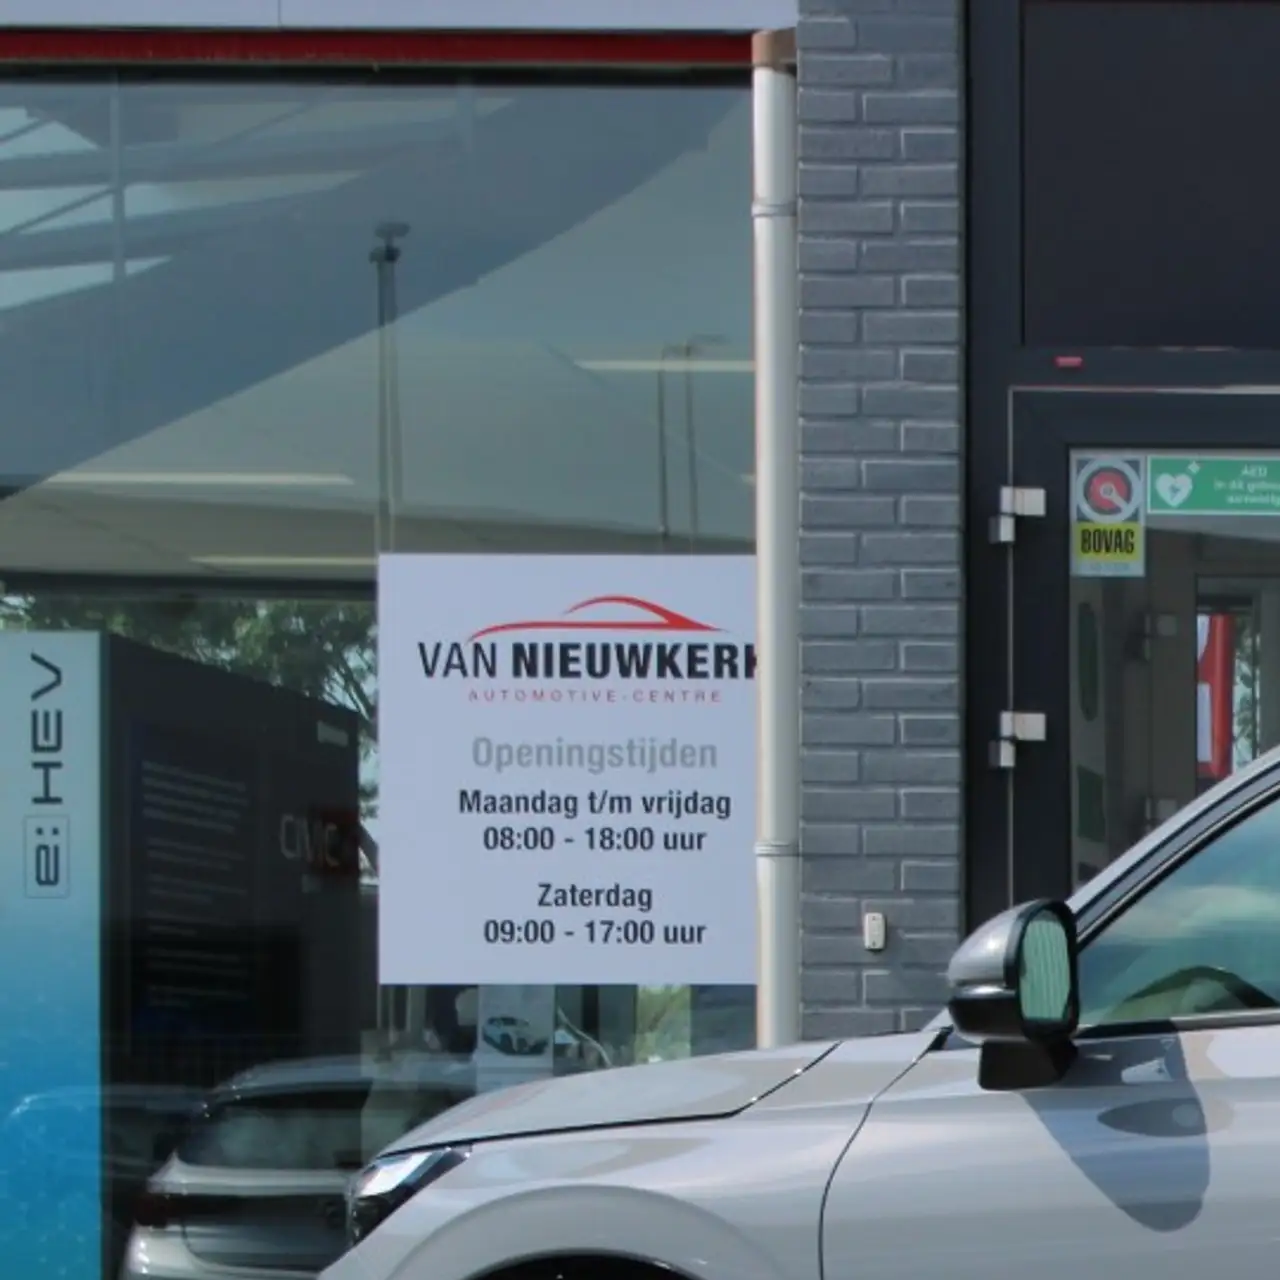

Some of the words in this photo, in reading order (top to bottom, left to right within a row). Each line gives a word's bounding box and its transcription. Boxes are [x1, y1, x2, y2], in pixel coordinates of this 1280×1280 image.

[1080, 528, 1136, 555] BOVAG
[418, 642, 497, 679] VAN
[472, 737, 718, 774] Openingstijden
[458, 788, 579, 819] Maandag
[587, 789, 632, 815] t/m
[640, 789, 732, 820] vrijdag
[483, 826, 556, 850] 08:00
[584, 826, 655, 851] 18:00
[663, 831, 707, 851] uur
[537, 882, 653, 914] Zaterdag
[483, 919, 556, 944] 09:00
[584, 919, 656, 944] 17:00
[663, 924, 707, 944] uur
